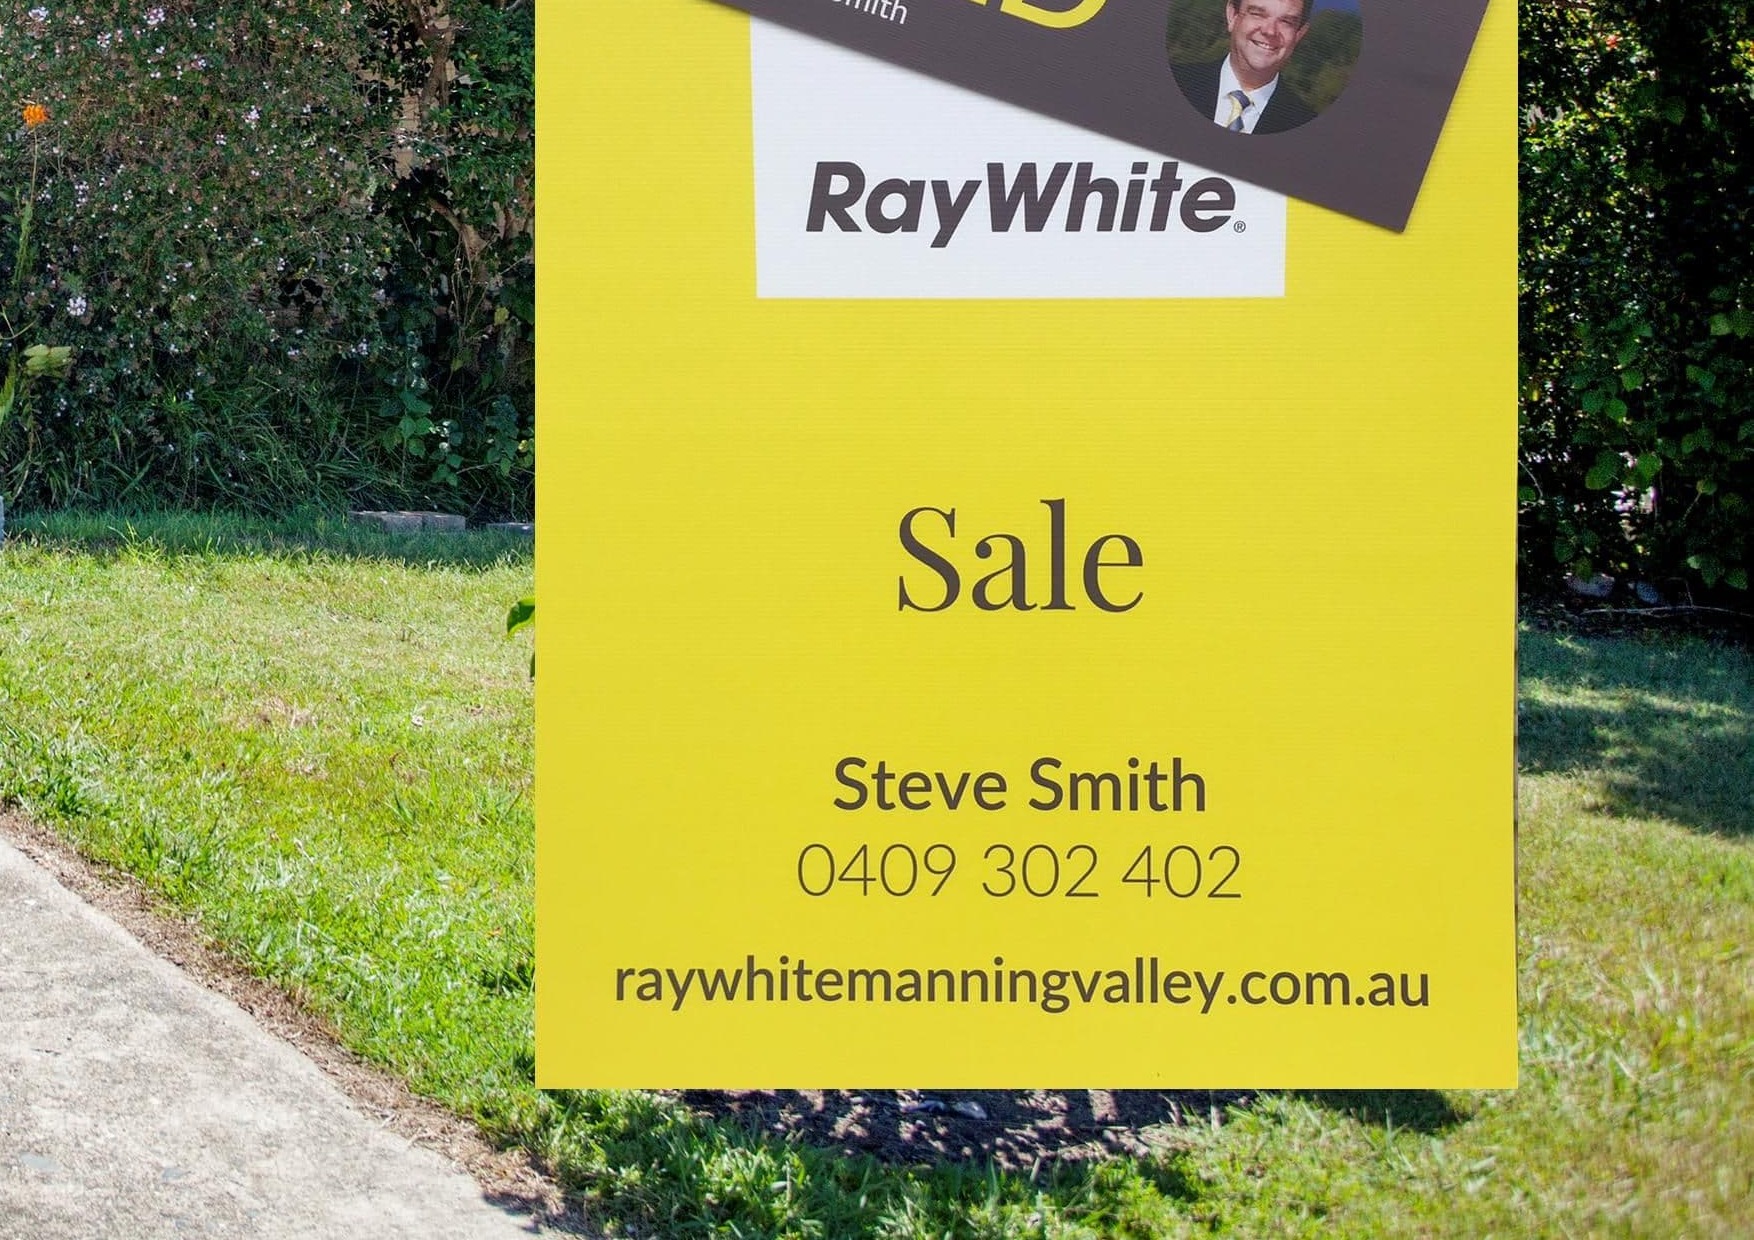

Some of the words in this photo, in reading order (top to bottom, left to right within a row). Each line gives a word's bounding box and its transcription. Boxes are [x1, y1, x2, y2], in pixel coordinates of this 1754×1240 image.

[899, 498, 1144, 613] Sale
[833, 756, 1007, 811] Steve
[1028, 757, 1206, 812] Smith
[797, 843, 957, 897] 0409
[982, 844, 1099, 898] 302
[1121, 845, 1242, 898] 402
[616, 954, 1430, 1015] raywhitemanningvalley.com.au
